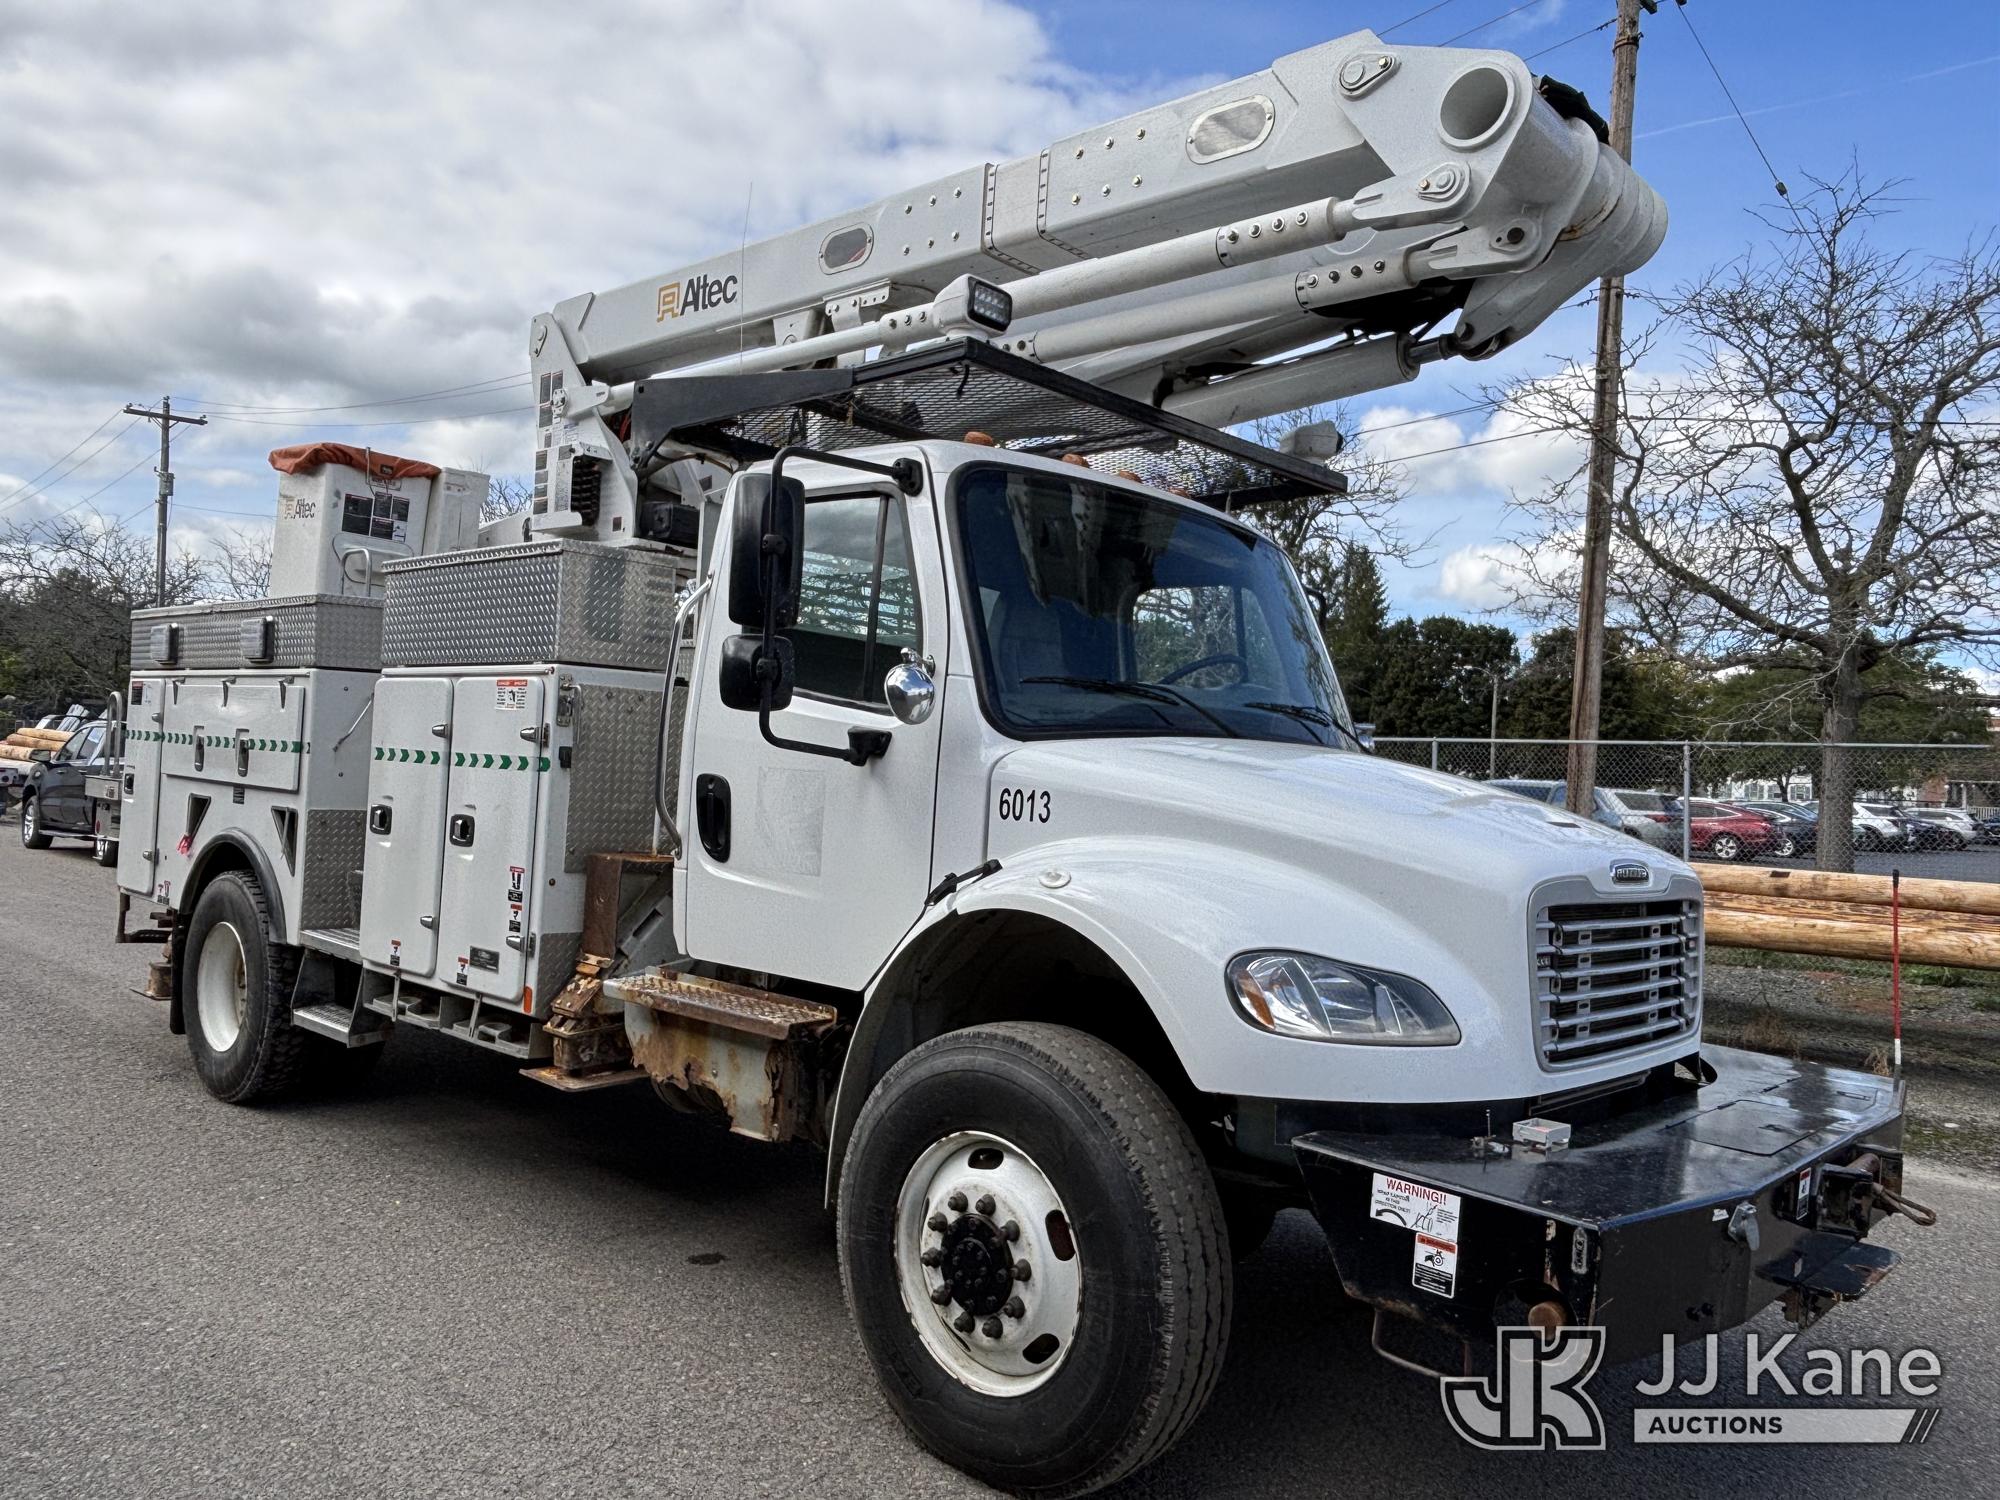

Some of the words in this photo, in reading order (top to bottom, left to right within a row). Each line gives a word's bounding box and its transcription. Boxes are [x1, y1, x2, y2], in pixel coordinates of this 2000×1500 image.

[680, 274, 738, 316] Altec
[293, 497, 317, 519] Altec
[999, 787, 1051, 824] 6013
[1386, 1178, 1447, 1205] WARNING!!
